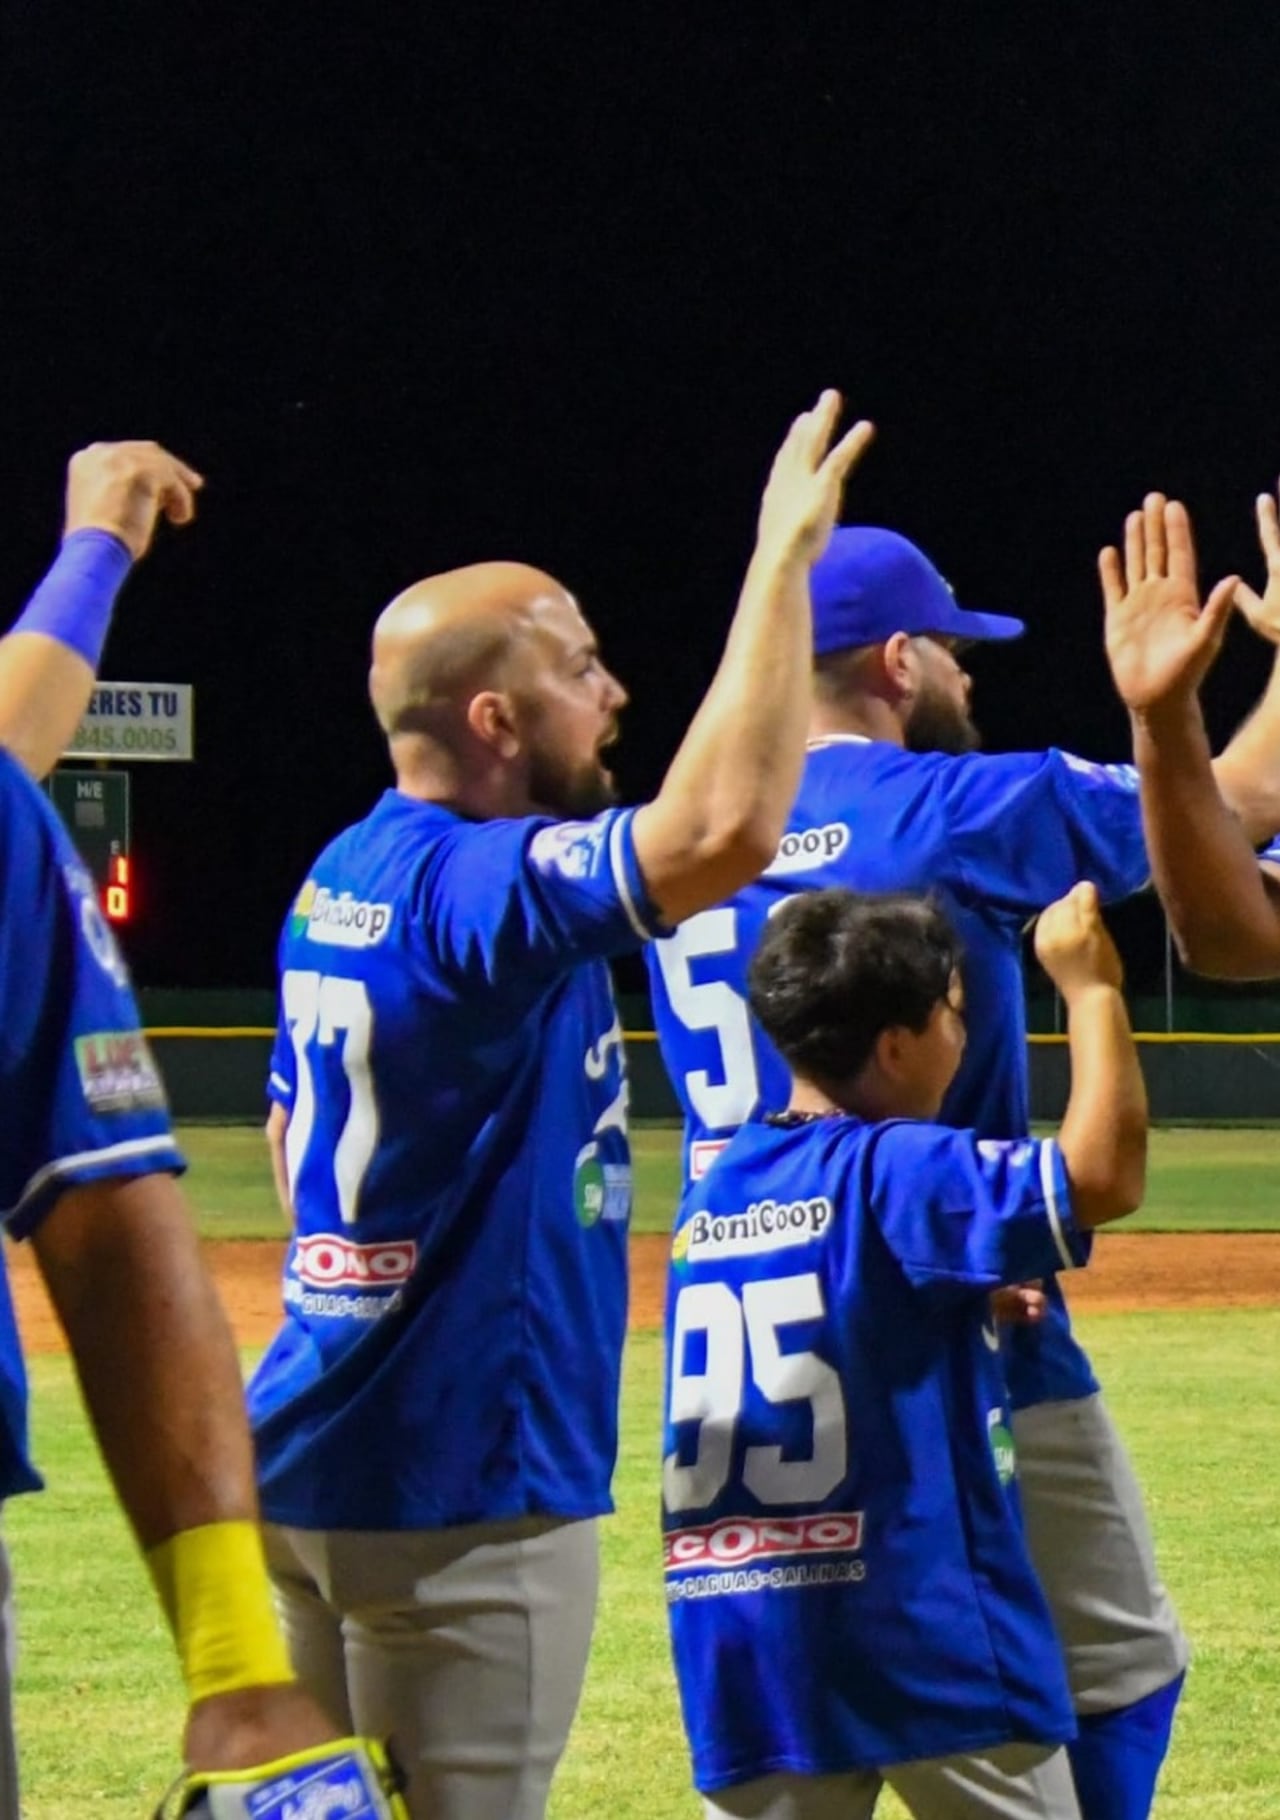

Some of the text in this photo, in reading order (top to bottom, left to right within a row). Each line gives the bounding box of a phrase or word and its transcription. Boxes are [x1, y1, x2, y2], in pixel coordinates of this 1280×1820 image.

[148, 690, 178, 718] TU
[116, 857, 128, 885] 1
[106, 886, 129, 918] 0
[282, 970, 379, 1225] 77
[692, 1201, 828, 1245] BoniCoop
[663, 1272, 848, 1515] 95
